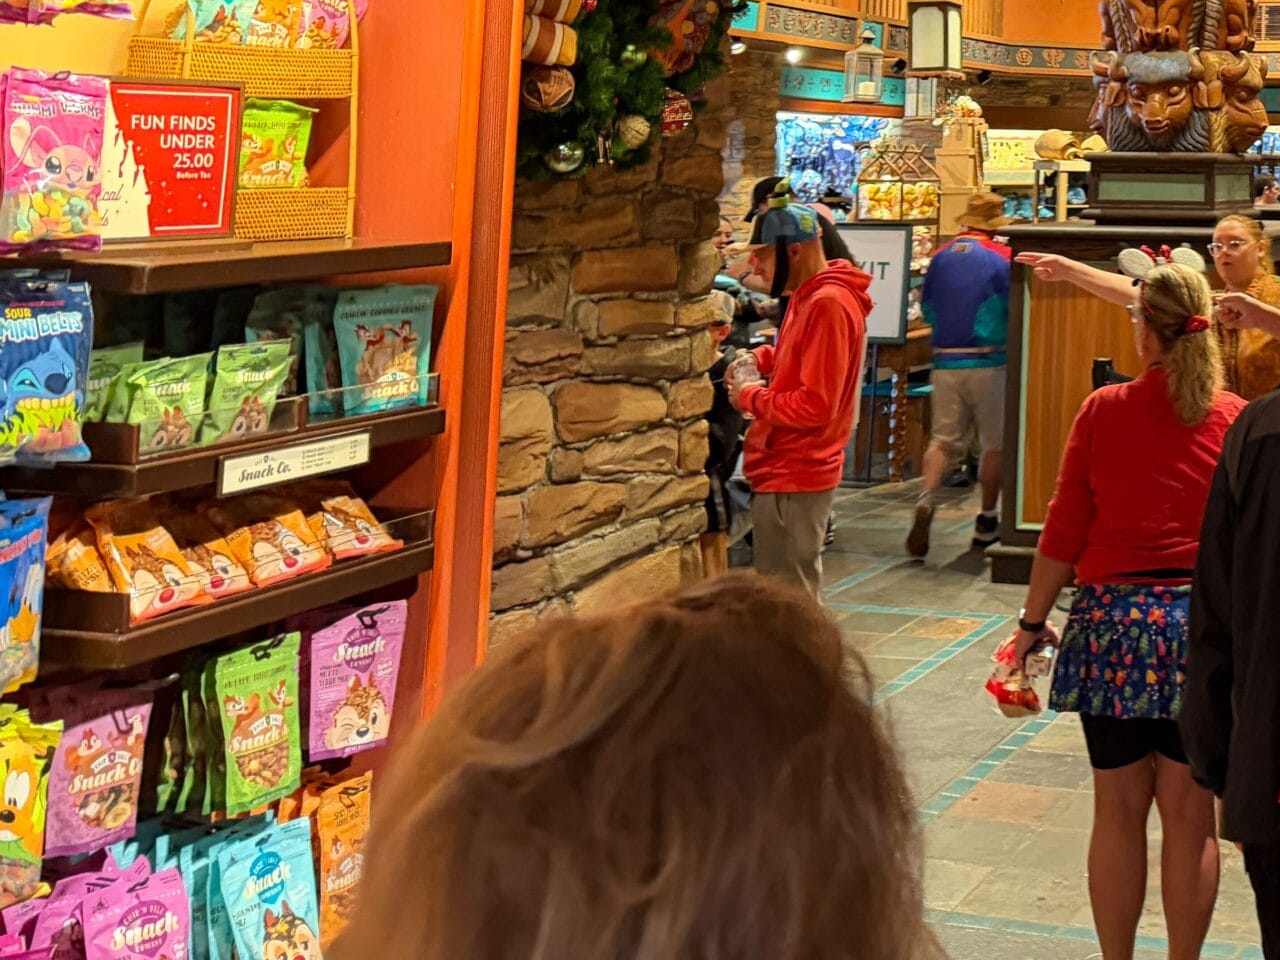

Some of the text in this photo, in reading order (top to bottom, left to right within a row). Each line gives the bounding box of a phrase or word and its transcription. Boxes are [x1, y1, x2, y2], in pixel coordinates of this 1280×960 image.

[131, 114, 216, 131] FUN FINDS
[160, 134, 215, 149] UNDER
[173, 153, 214, 168] 25.00
[176, 171, 198, 179] Before
[5, 307, 31, 319] SOUR
[0, 311, 83, 343] MINI BELTS
[238, 464, 274, 483] Snack
[276, 461, 291, 474] Co.
[333, 635, 386, 661] Snack
[228, 727, 280, 754] Snack
[68, 763, 126, 794] Snack
[243, 862, 291, 899] Snack
[110, 911, 180, 951] Snack
